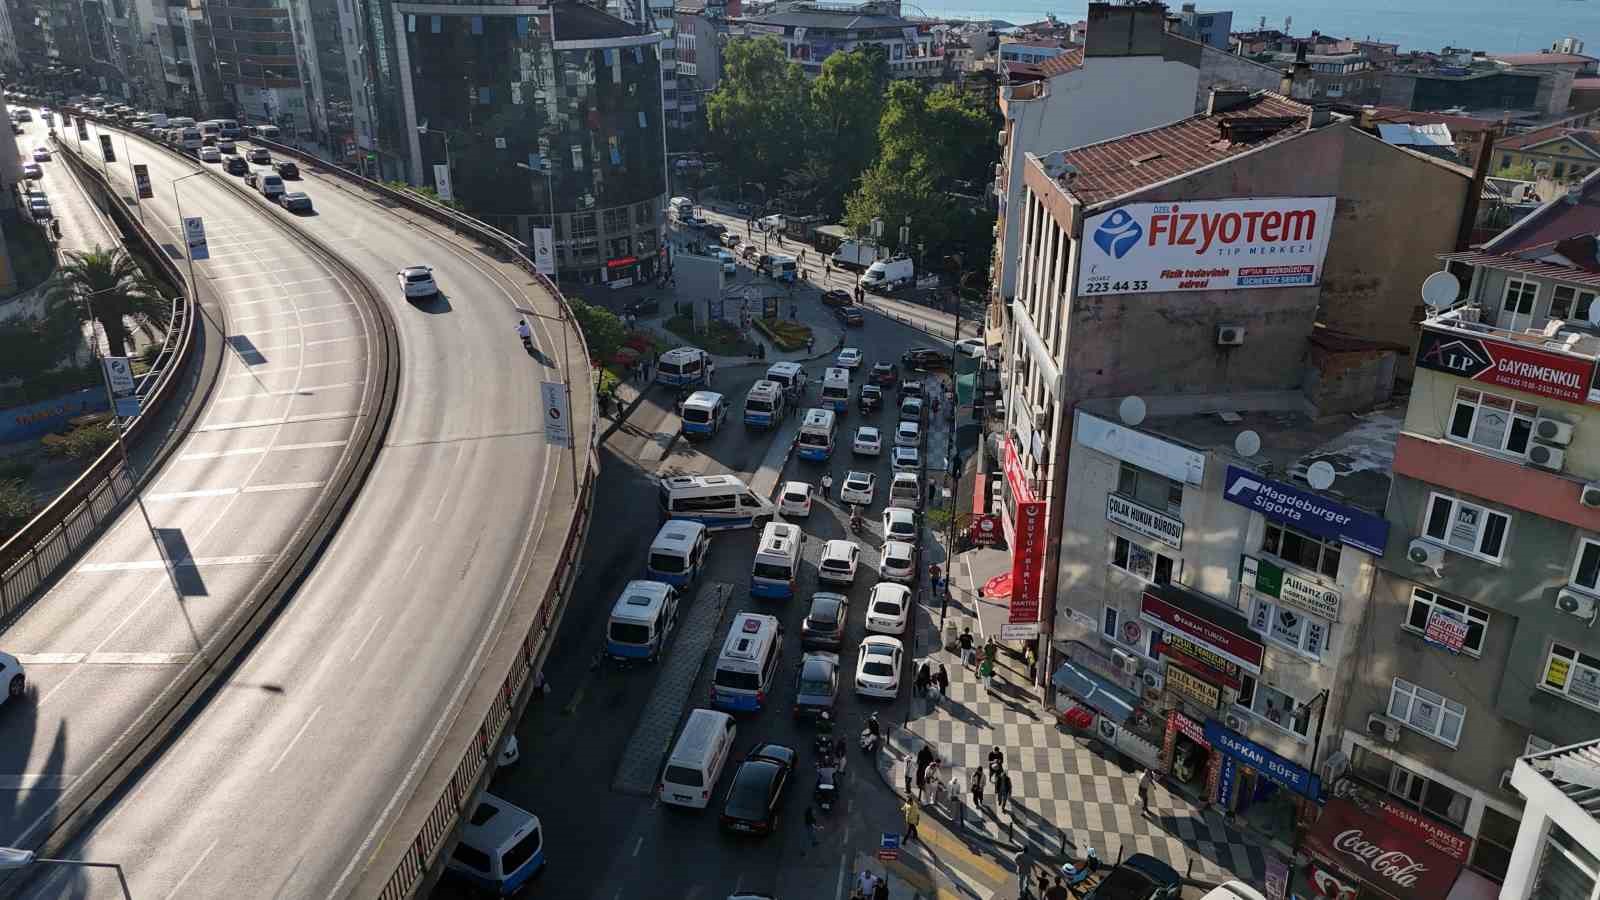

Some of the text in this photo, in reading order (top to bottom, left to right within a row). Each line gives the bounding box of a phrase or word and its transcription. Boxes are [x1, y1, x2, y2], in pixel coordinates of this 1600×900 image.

[1086, 280, 1149, 293] 223 44 33
[1254, 495, 1302, 521] Sigorta
[1259, 483, 1352, 525] Magdeburger
[1284, 576, 1321, 599] Allianz
[1219, 734, 1301, 784] SAFKAN BÜFE
[1419, 822, 1466, 849] MARKET
